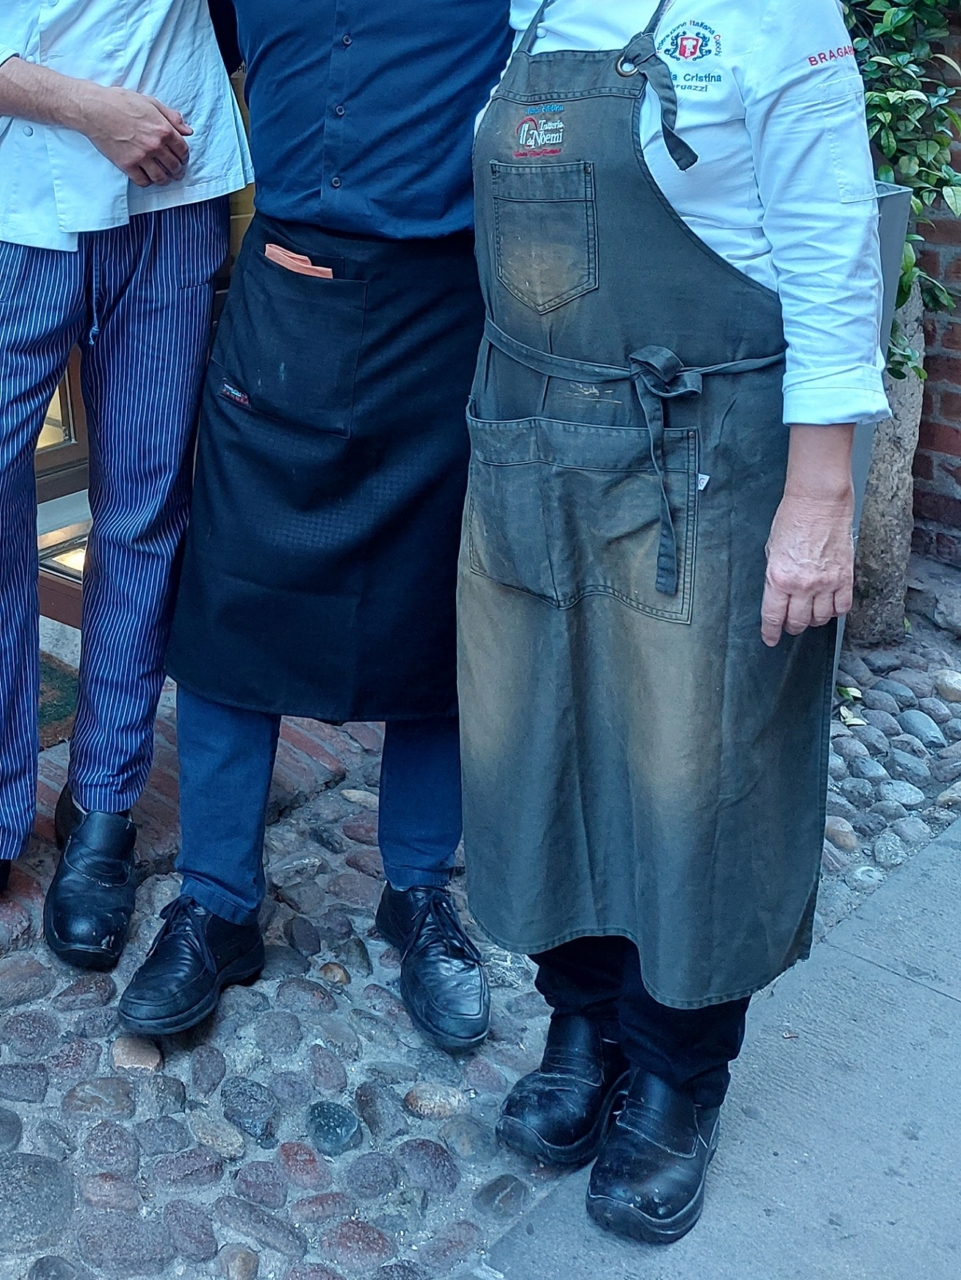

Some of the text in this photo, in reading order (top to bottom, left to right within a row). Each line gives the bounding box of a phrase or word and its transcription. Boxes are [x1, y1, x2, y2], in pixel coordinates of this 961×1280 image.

[689, 19, 716, 36] Italiana
[683, 72, 722, 83] Cristina
[530, 129, 564, 149] Noemi
